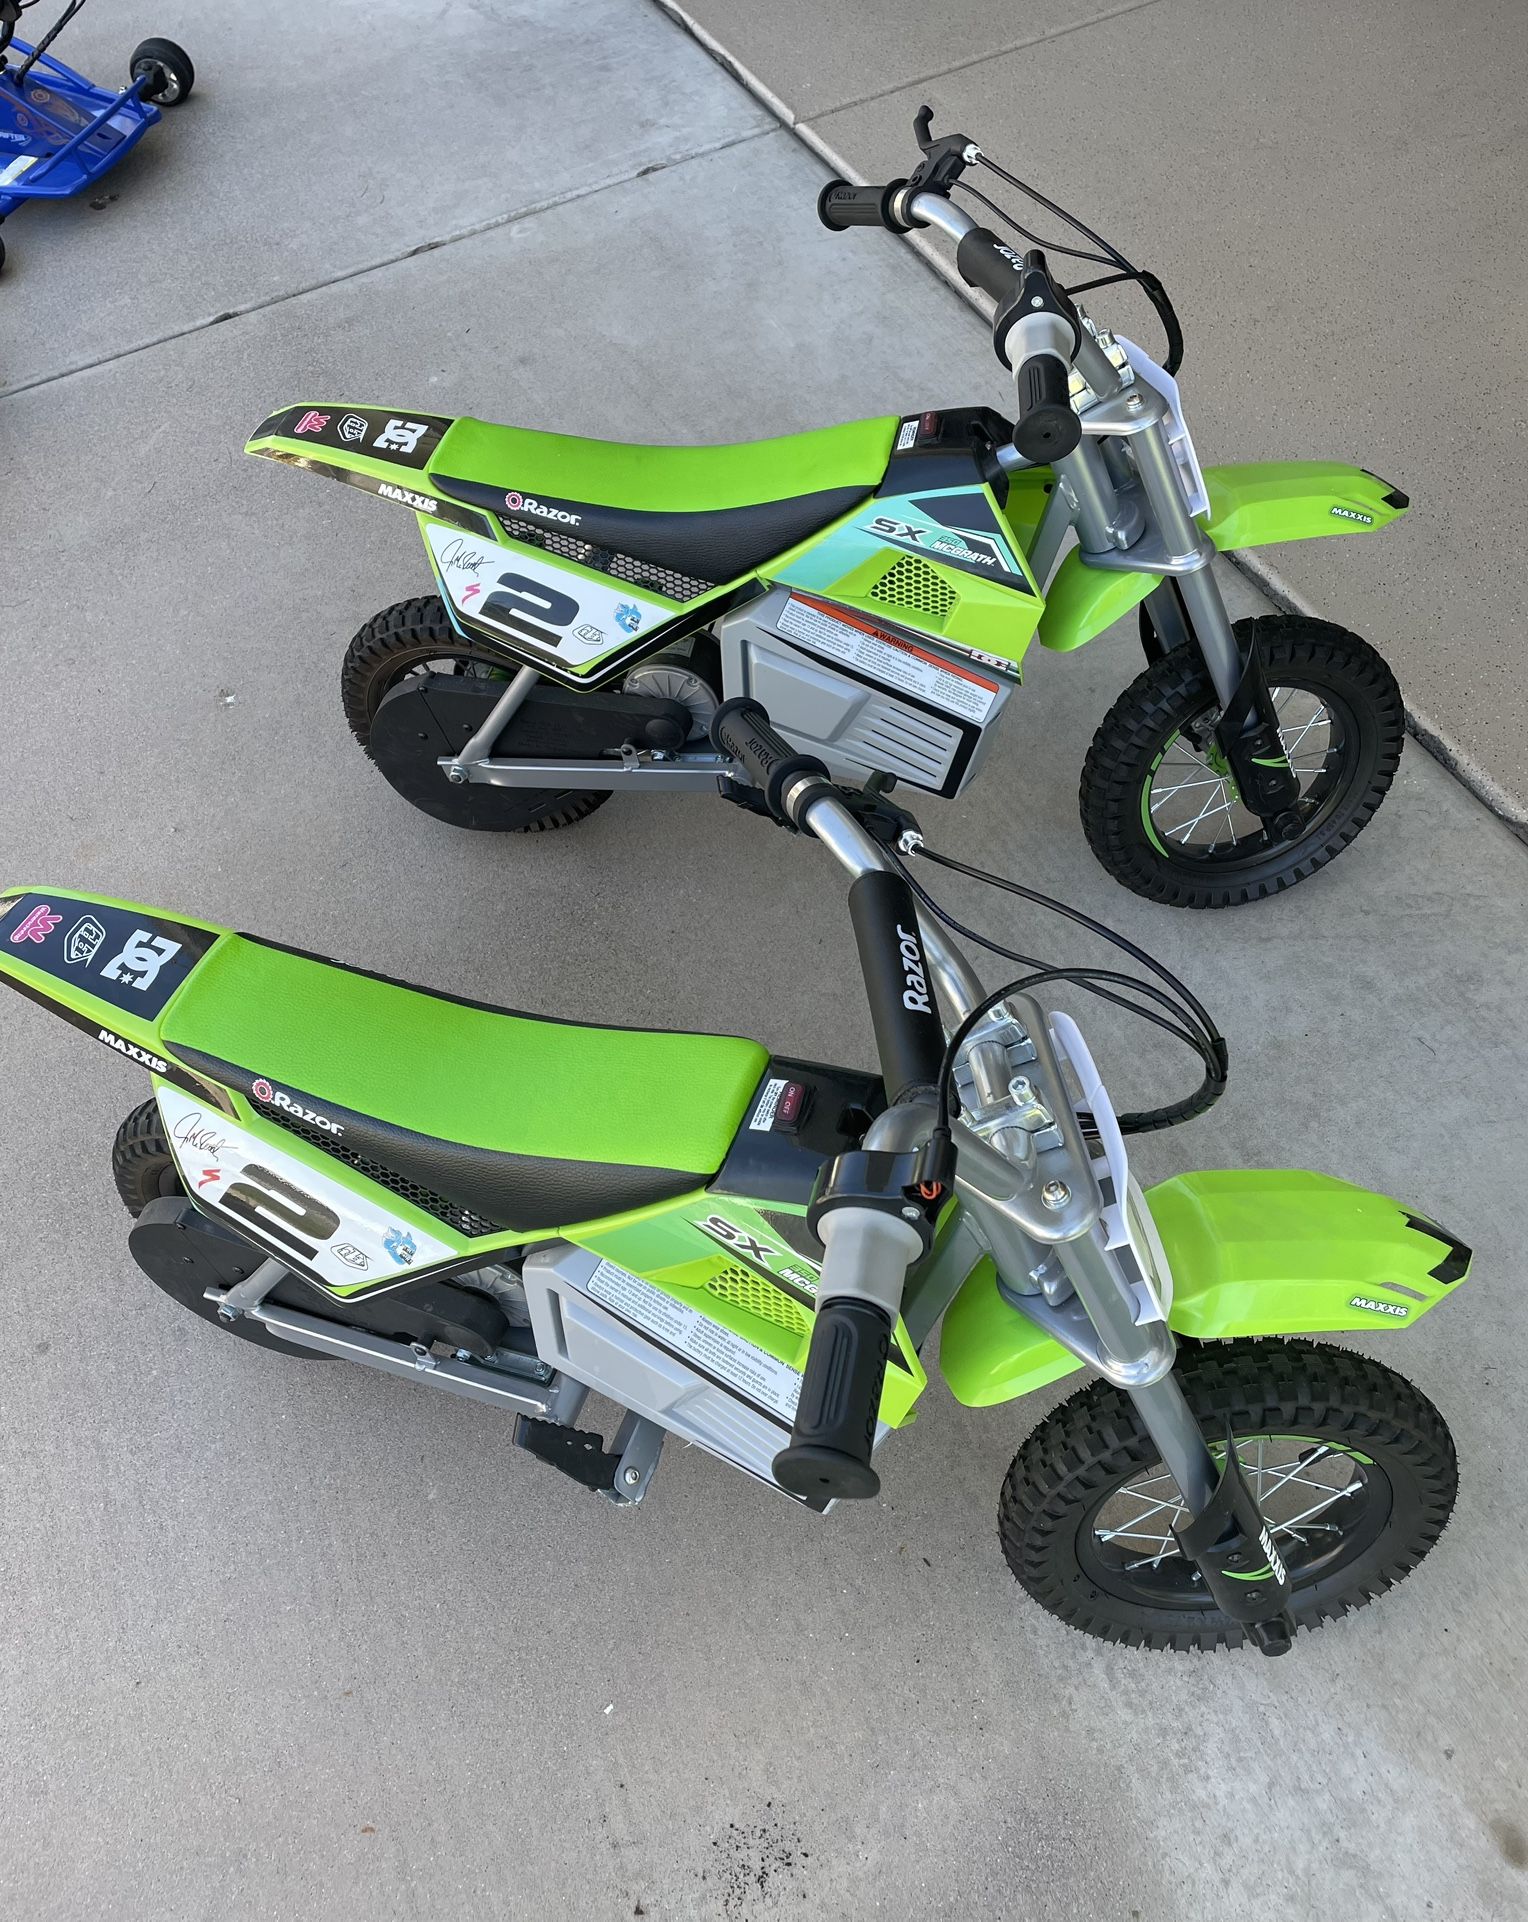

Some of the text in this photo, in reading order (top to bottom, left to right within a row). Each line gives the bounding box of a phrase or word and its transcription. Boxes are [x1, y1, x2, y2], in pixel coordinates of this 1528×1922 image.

[377, 483, 438, 512] MAXXIS
[1331, 507, 1372, 524] MAXXIS
[869, 516, 928, 543] SX
[478, 572, 580, 648] 2
[879, 632, 914, 653] WARNING
[897, 924, 932, 1014] Razor
[98, 1029, 168, 1073] MAXXIS
[219, 1163, 340, 1261] 2
[702, 1216, 775, 1264] SX
[1350, 1297, 1408, 1316] MAXXIS
[1259, 1525, 1286, 1586] MAXXIS
